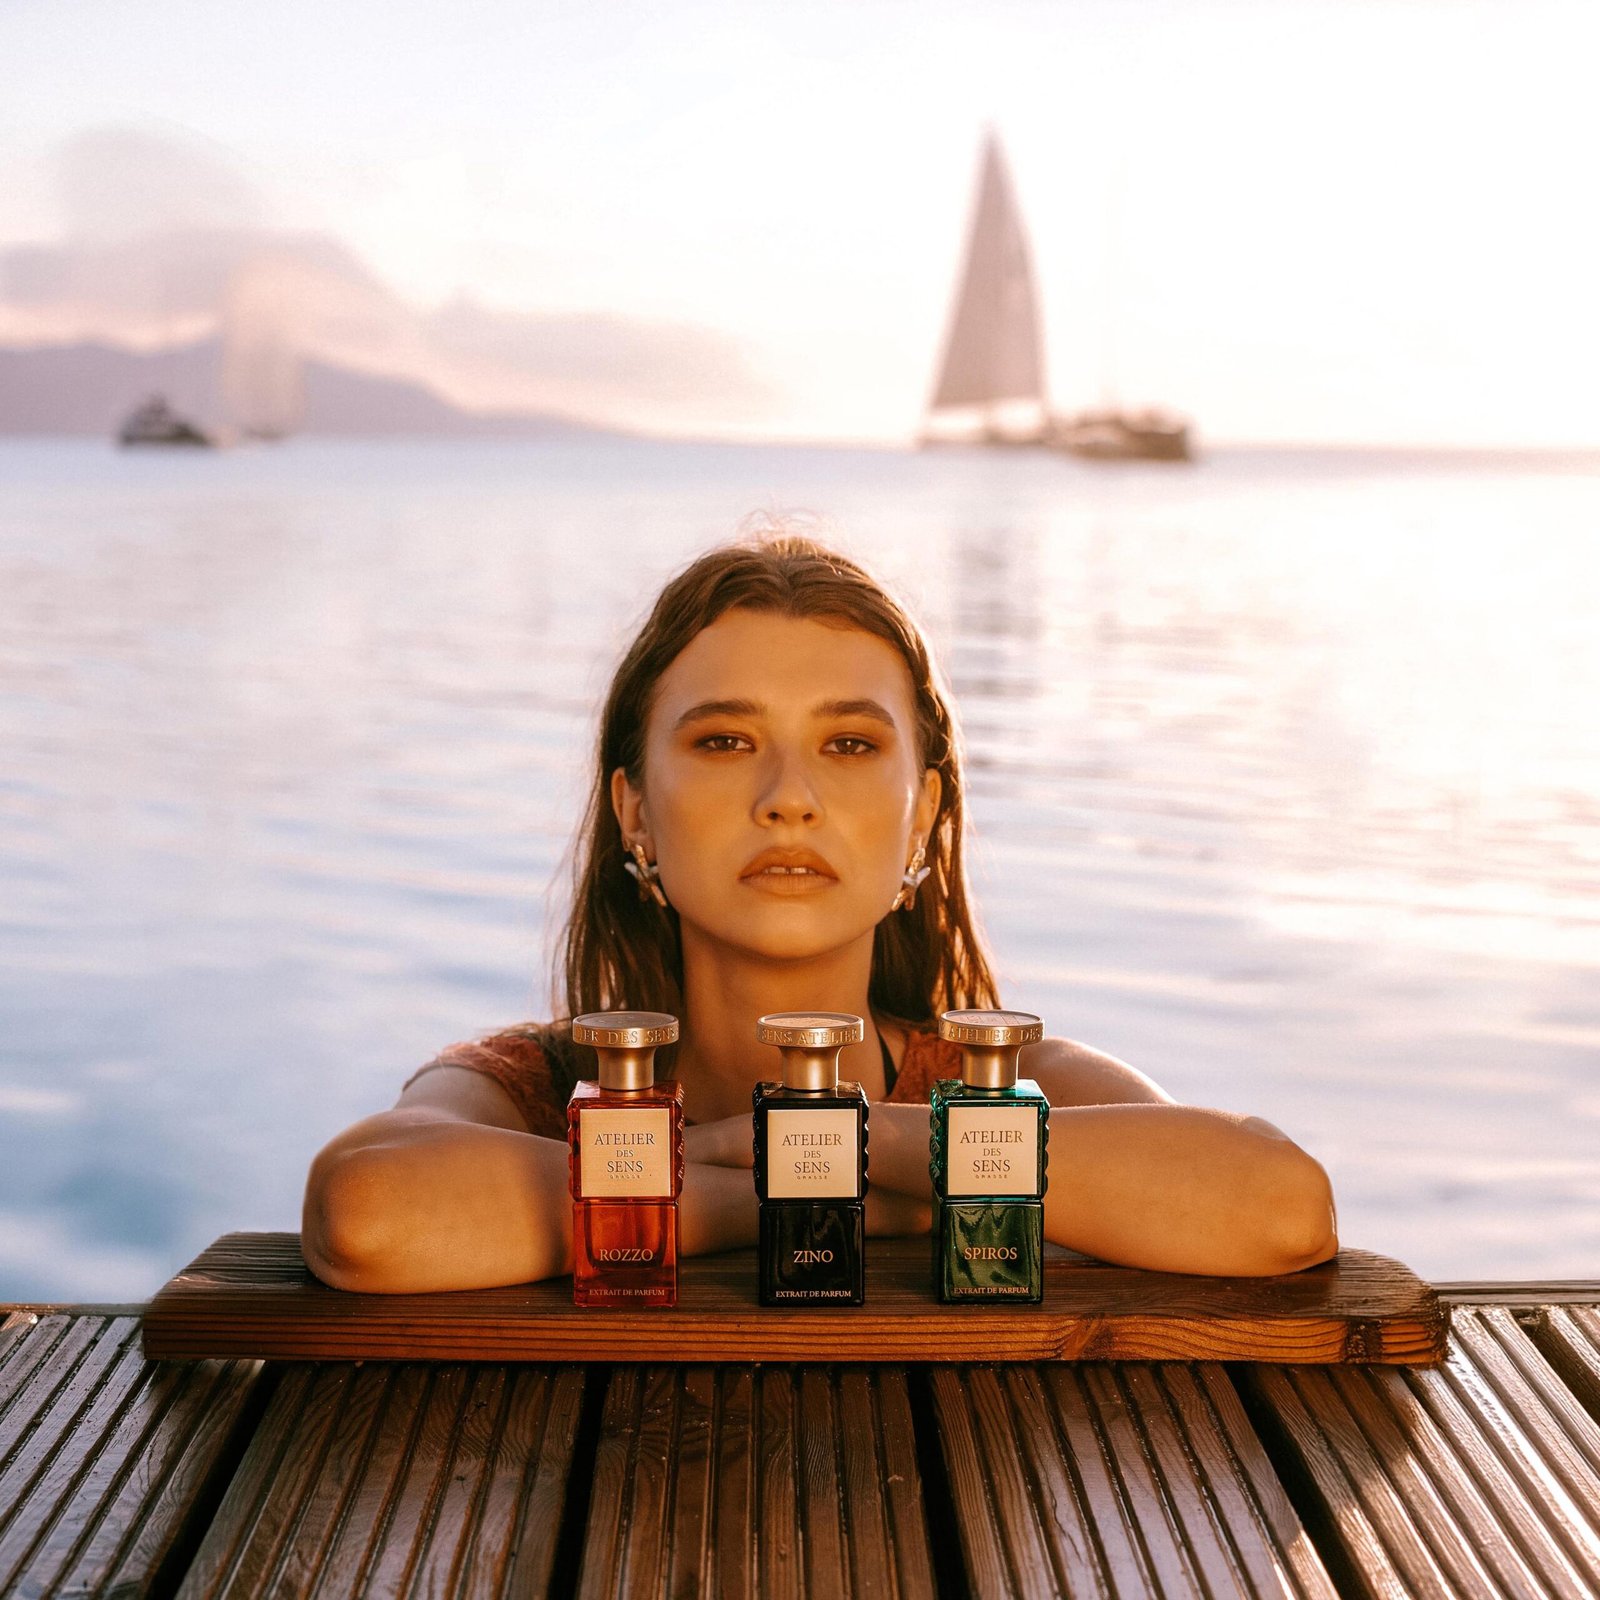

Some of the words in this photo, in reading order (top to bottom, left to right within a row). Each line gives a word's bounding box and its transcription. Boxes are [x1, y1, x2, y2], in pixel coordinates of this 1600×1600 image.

[608, 1031, 638, 1045] DES
[761, 1029, 793, 1043] SENS
[798, 1029, 857, 1045] ATELIER
[949, 1025, 1011, 1042] ATELIER
[594, 1133, 655, 1145] ATELIER
[782, 1134, 843, 1146] ATELIER
[960, 1131, 1024, 1144] ATELIER
[616, 1150, 634, 1158] DES
[804, 1151, 822, 1159] DES
[983, 1148, 1002, 1157] DES
[607, 1161, 643, 1173] SENS
[794, 1162, 831, 1174] SENS
[972, 1160, 1011, 1172] SENS
[599, 1248, 654, 1262] ROZZO
[793, 1250, 834, 1263] ZINO
[964, 1247, 1018, 1260] SPIROS
[821, 1290, 852, 1298] PARFUM
